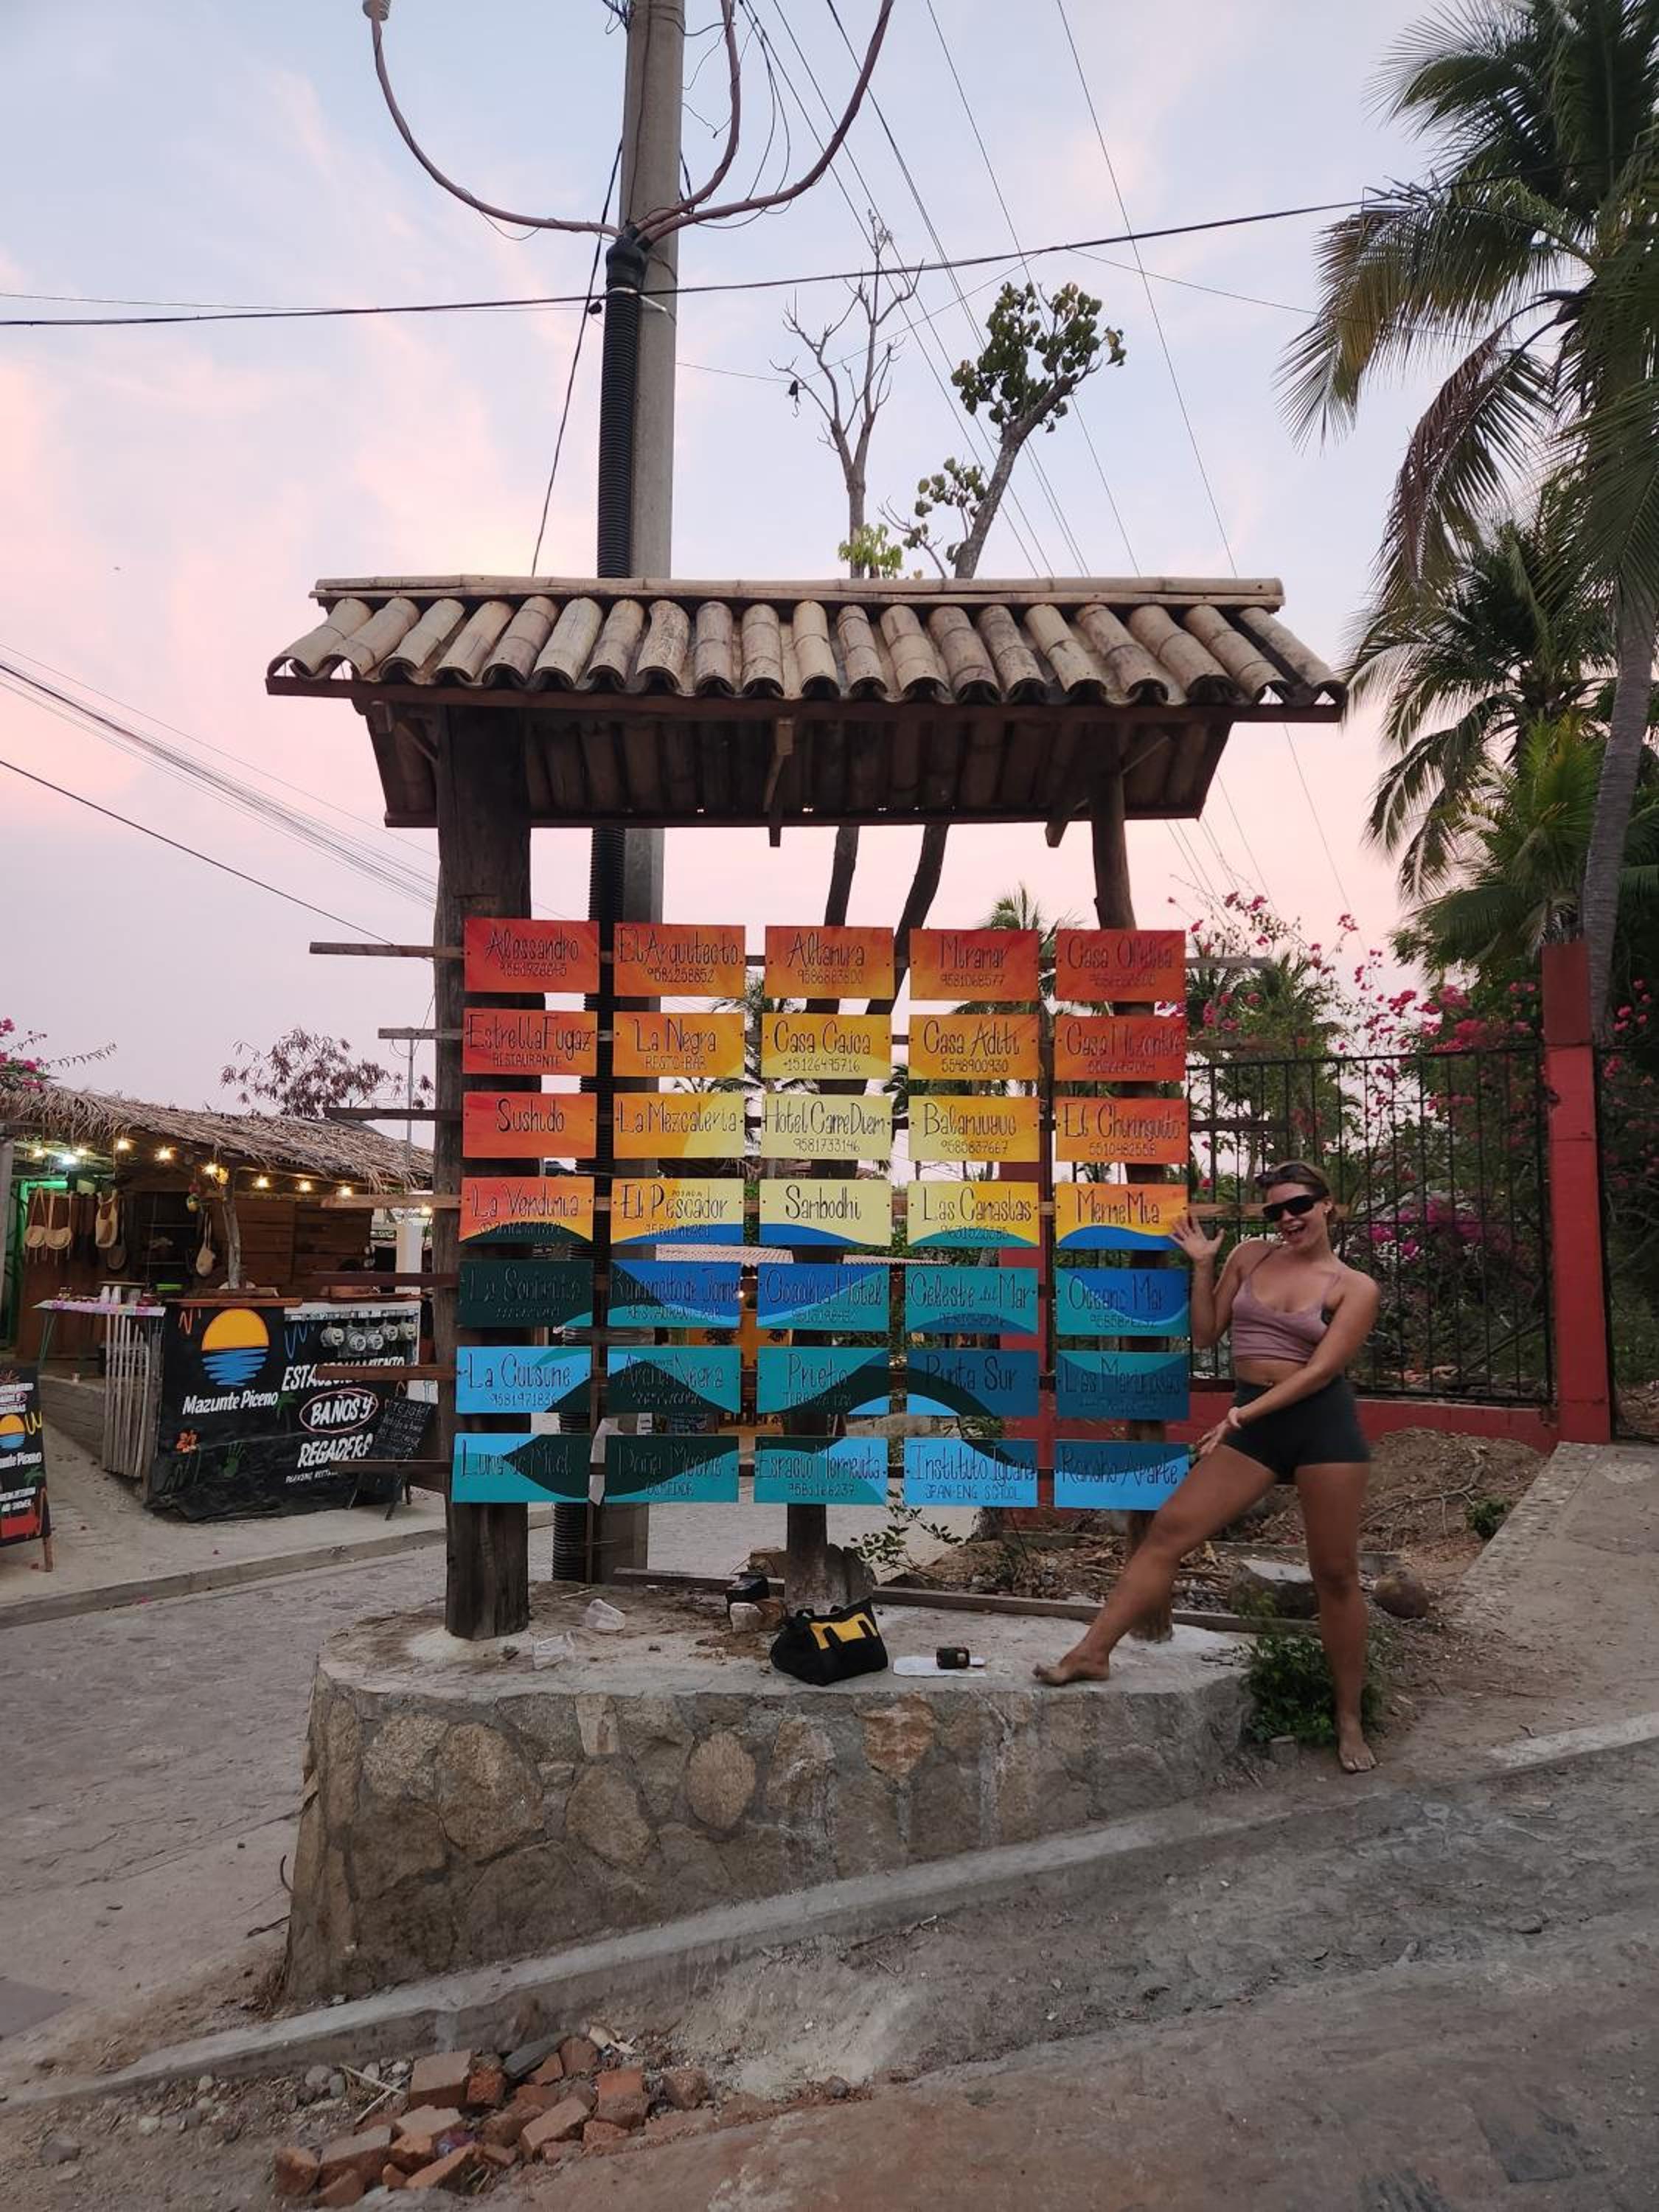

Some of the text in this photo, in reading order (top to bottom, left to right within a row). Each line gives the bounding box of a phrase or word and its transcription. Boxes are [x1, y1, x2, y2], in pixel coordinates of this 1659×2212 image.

[484, 927, 580, 961] Alessandro
[787, 931, 866, 968] Altamira
[939, 933, 1009, 969] Miramar
[1068, 935, 1109, 969] Casa
[632, 1018, 717, 1055] La Negra
[774, 1019, 815, 1054] Casa
[923, 1019, 965, 1054] Casa
[1066, 1021, 1107, 1057] Casa
[493, 1051, 561, 1068] RESTAURANTE
[497, 1098, 565, 1133] Sushido
[618, 1100, 644, 1133] La
[765, 1099, 808, 1134] Hotel
[1062, 1102, 1088, 1138] El
[471, 1184, 498, 1218] La
[620, 1183, 728, 1220] El Pescador
[785, 1183, 862, 1220] Sambodhi
[923, 1186, 956, 1222] Las
[835, 1270, 883, 1307] Hotel
[911, 1272, 975, 1308] Celeste
[998, 1273, 1031, 1310] Mar
[465, 1352, 571, 1390] La Cuisine
[984, 1355, 1017, 1391] Sur
[182, 1390, 279, 1415] Mazunte Piceno
[310, 1395, 361, 1427] BAÑOS
[910, 1444, 988, 1481] Instituto
